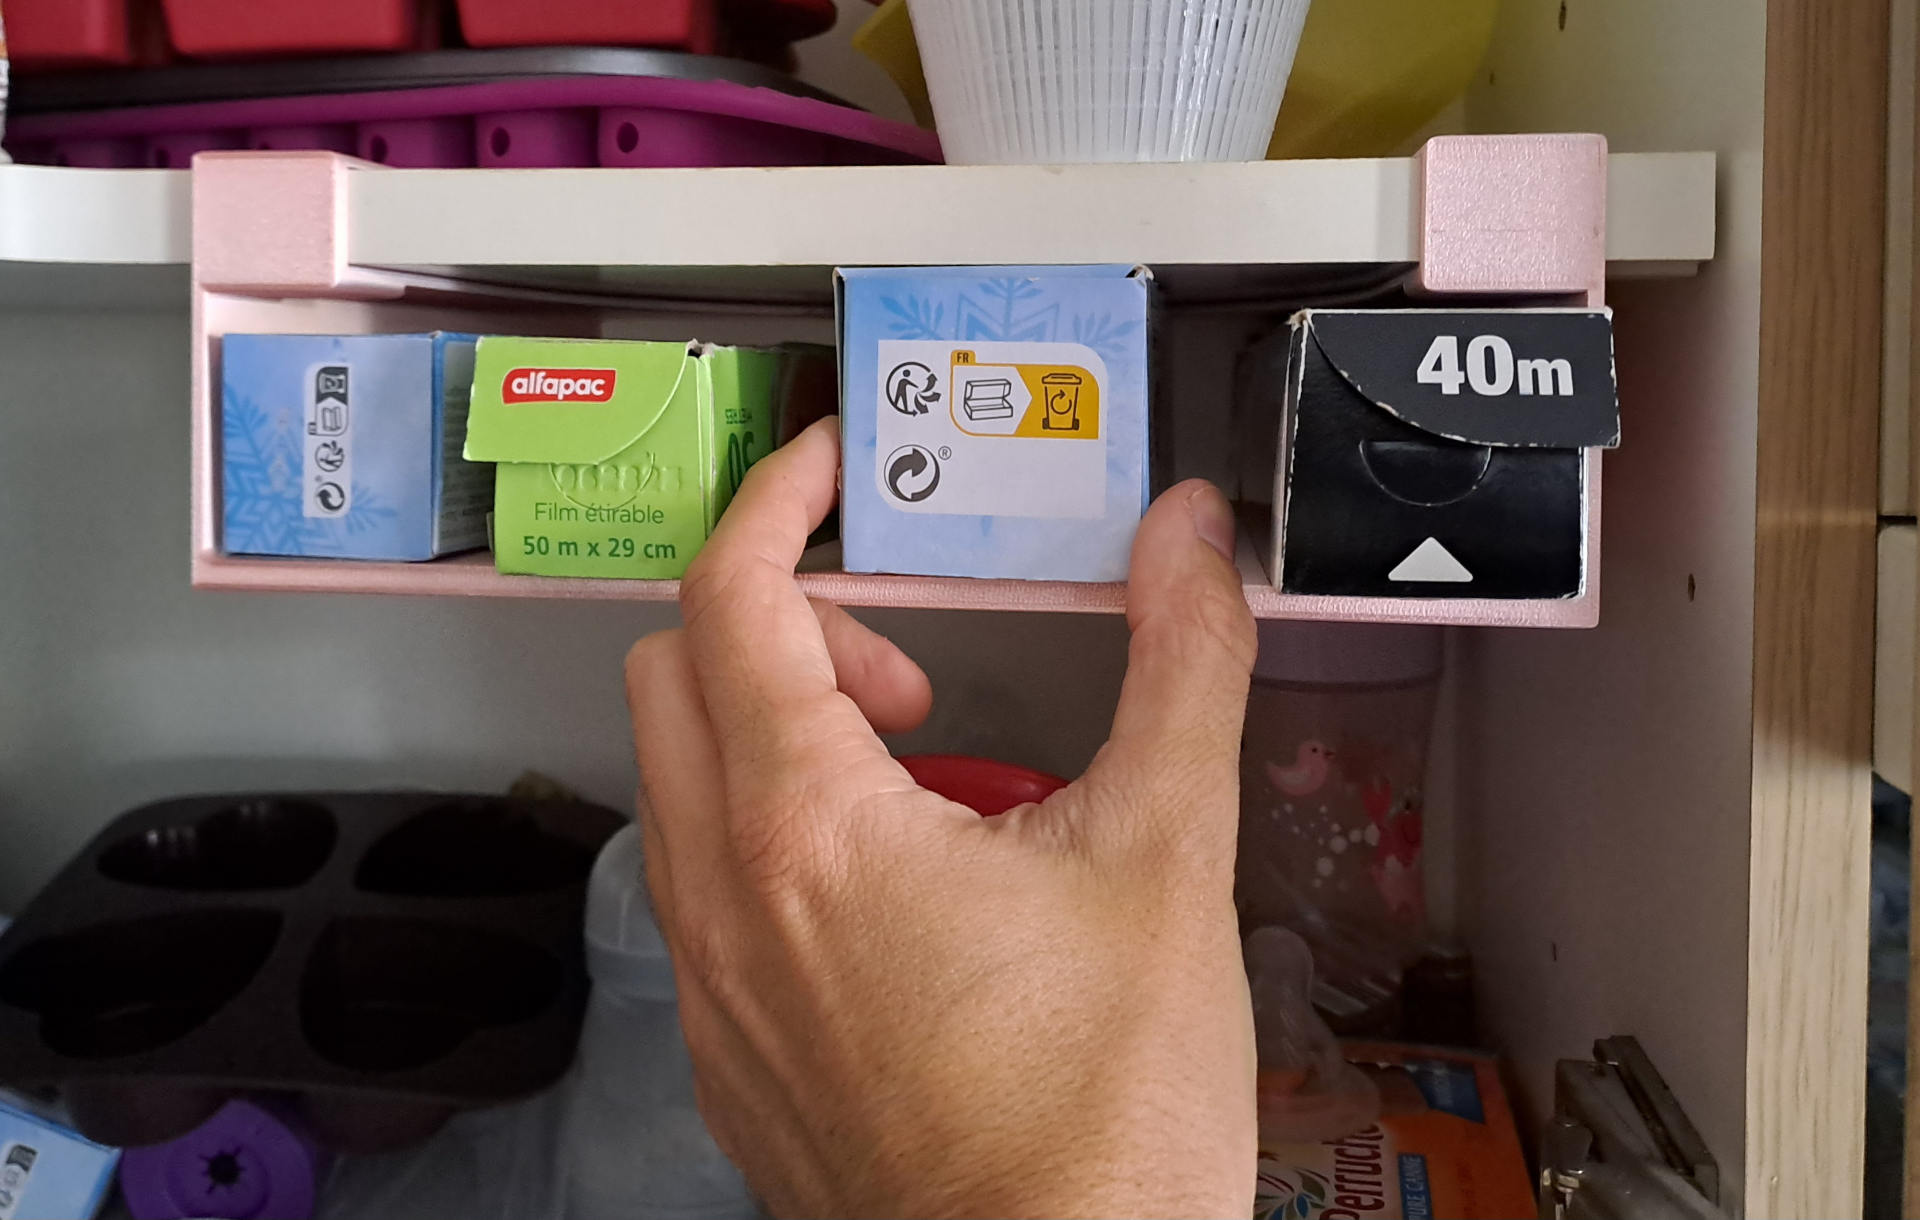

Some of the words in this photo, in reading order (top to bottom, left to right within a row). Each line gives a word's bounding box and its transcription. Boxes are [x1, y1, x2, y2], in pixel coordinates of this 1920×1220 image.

[956, 352, 970, 364] FR
[1416, 334, 1574, 397] 40m
[511, 371, 606, 399] alfapac
[534, 502, 578, 521] Film
[585, 502, 665, 524] étirable
[523, 535, 550, 556] 50
[558, 540, 579, 556] m
[587, 541, 601, 557] x
[608, 537, 636, 558] 29
[643, 542, 677, 560] cm
